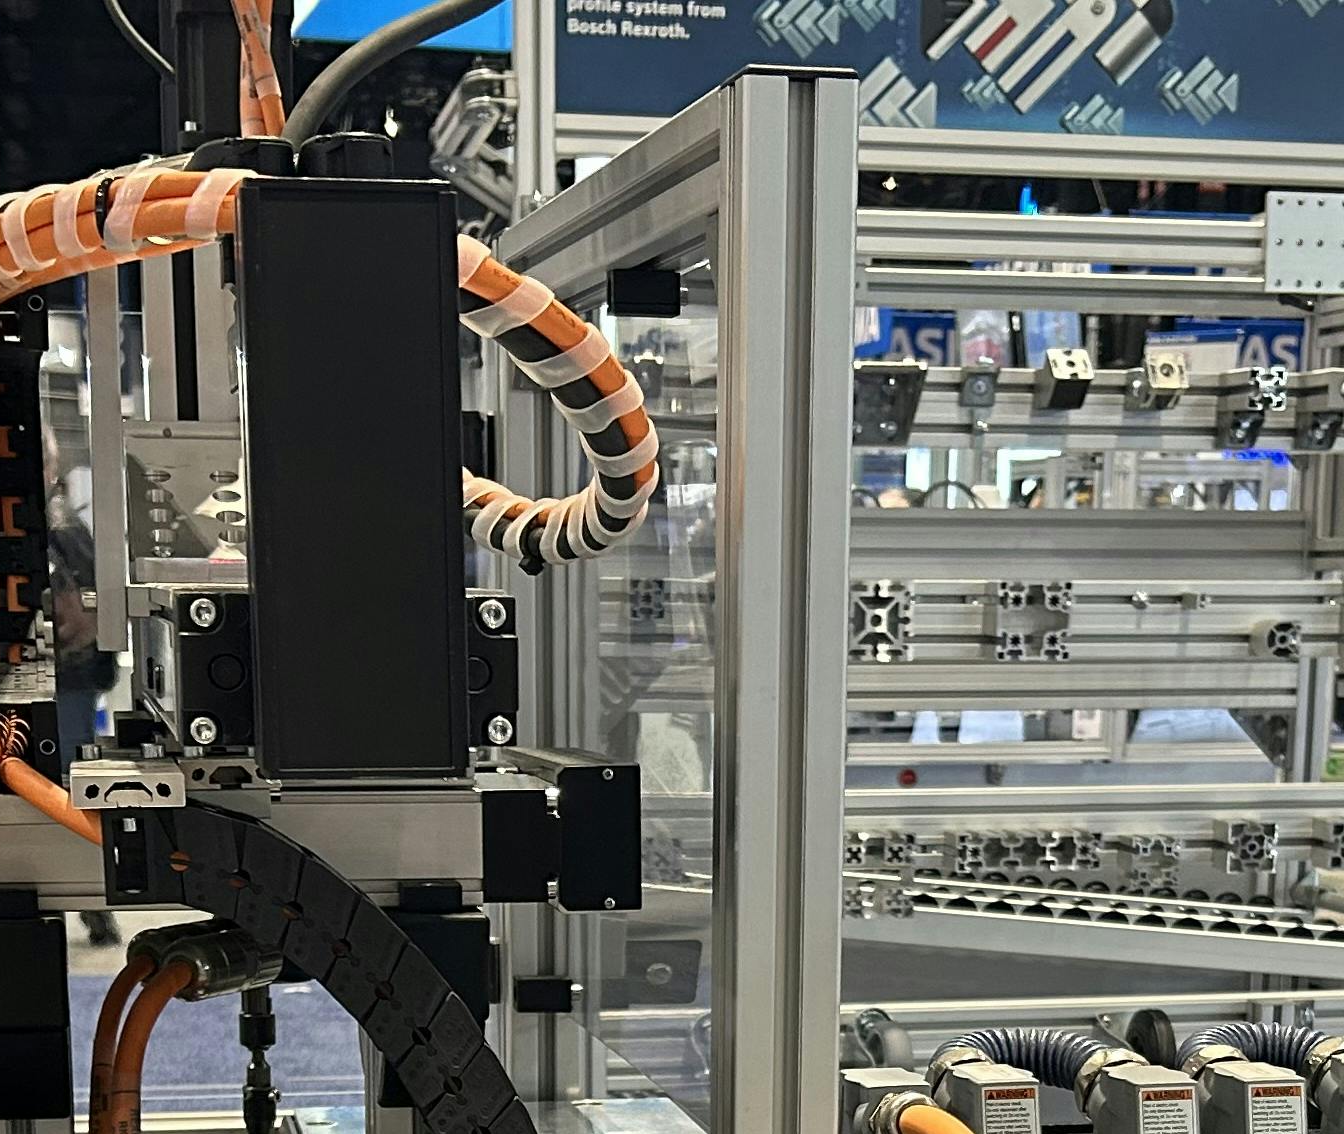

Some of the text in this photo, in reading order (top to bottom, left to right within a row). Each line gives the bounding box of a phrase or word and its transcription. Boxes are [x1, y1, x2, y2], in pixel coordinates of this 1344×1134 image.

[625, 1, 684, 16] system
[687, 1, 726, 18] from
[567, 18, 690, 39] Bosch Rexroth.
